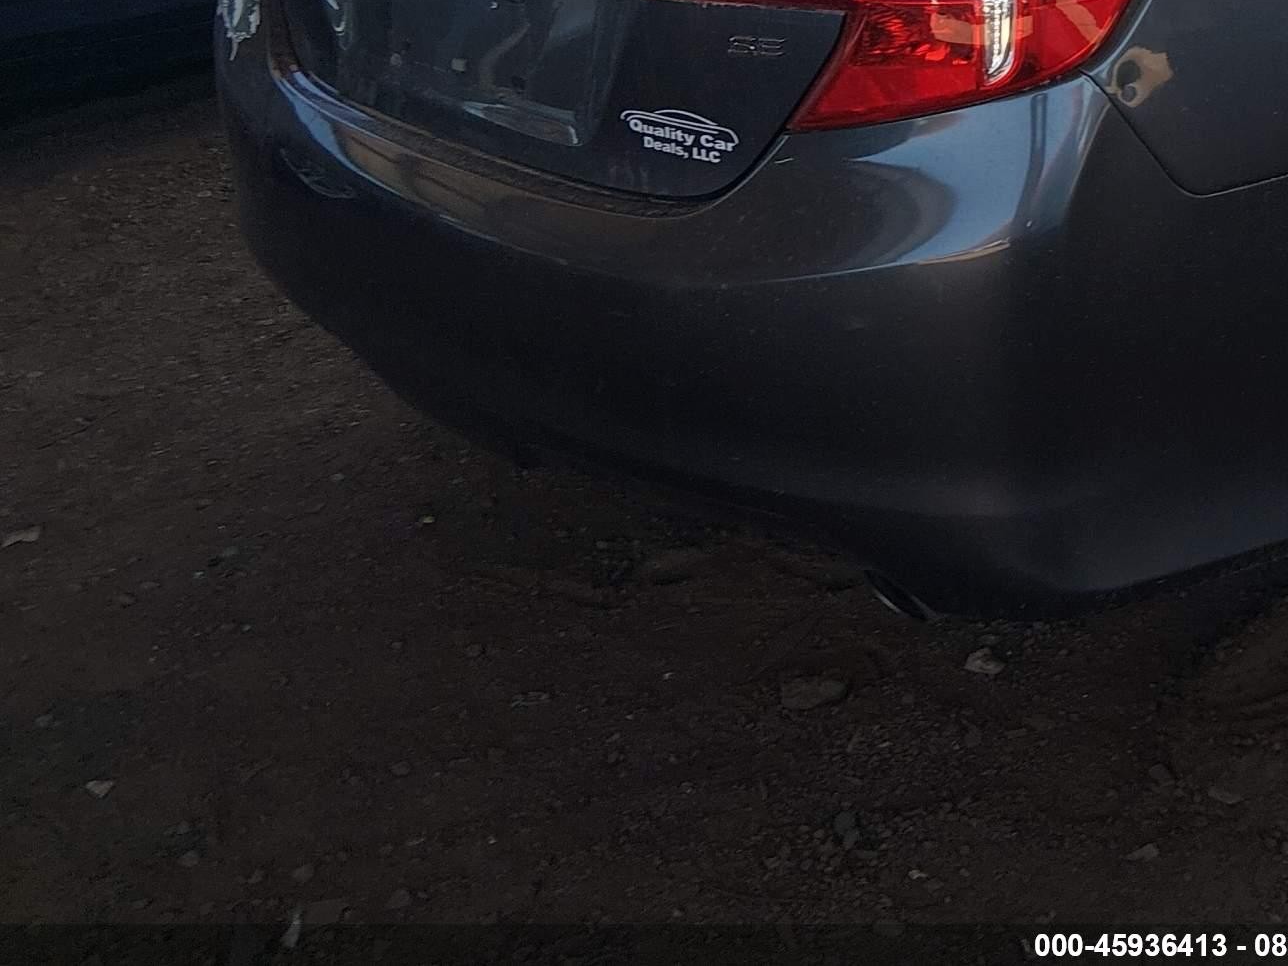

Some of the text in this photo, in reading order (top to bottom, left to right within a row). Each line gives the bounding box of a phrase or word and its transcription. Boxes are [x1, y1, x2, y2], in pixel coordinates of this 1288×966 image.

[728, 36, 786, 56] SE
[629, 119, 734, 152] Quality Car
[643, 136, 721, 163] Deals, LLC
